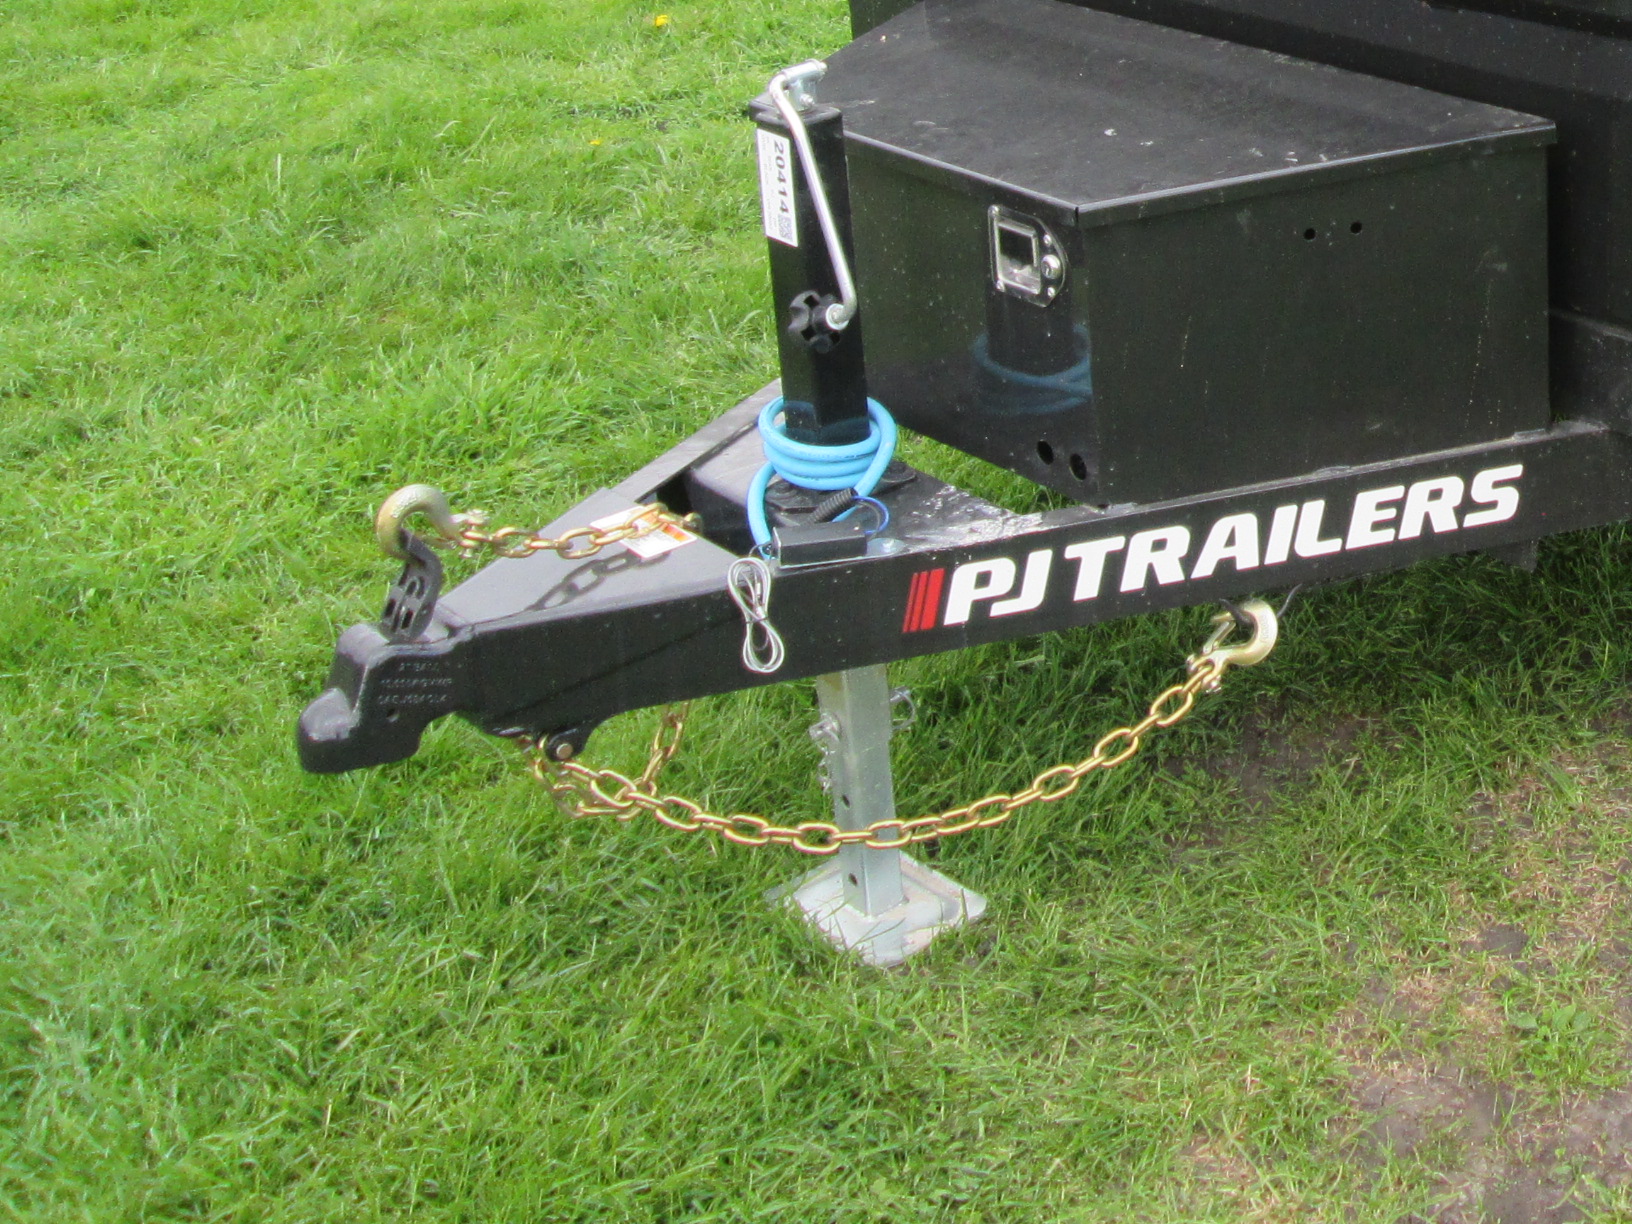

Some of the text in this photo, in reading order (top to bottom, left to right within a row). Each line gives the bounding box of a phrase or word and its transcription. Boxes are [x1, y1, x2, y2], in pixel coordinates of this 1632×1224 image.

[774, 139, 789, 214] 20414
[943, 464, 1524, 626] PJ TRAILERS
